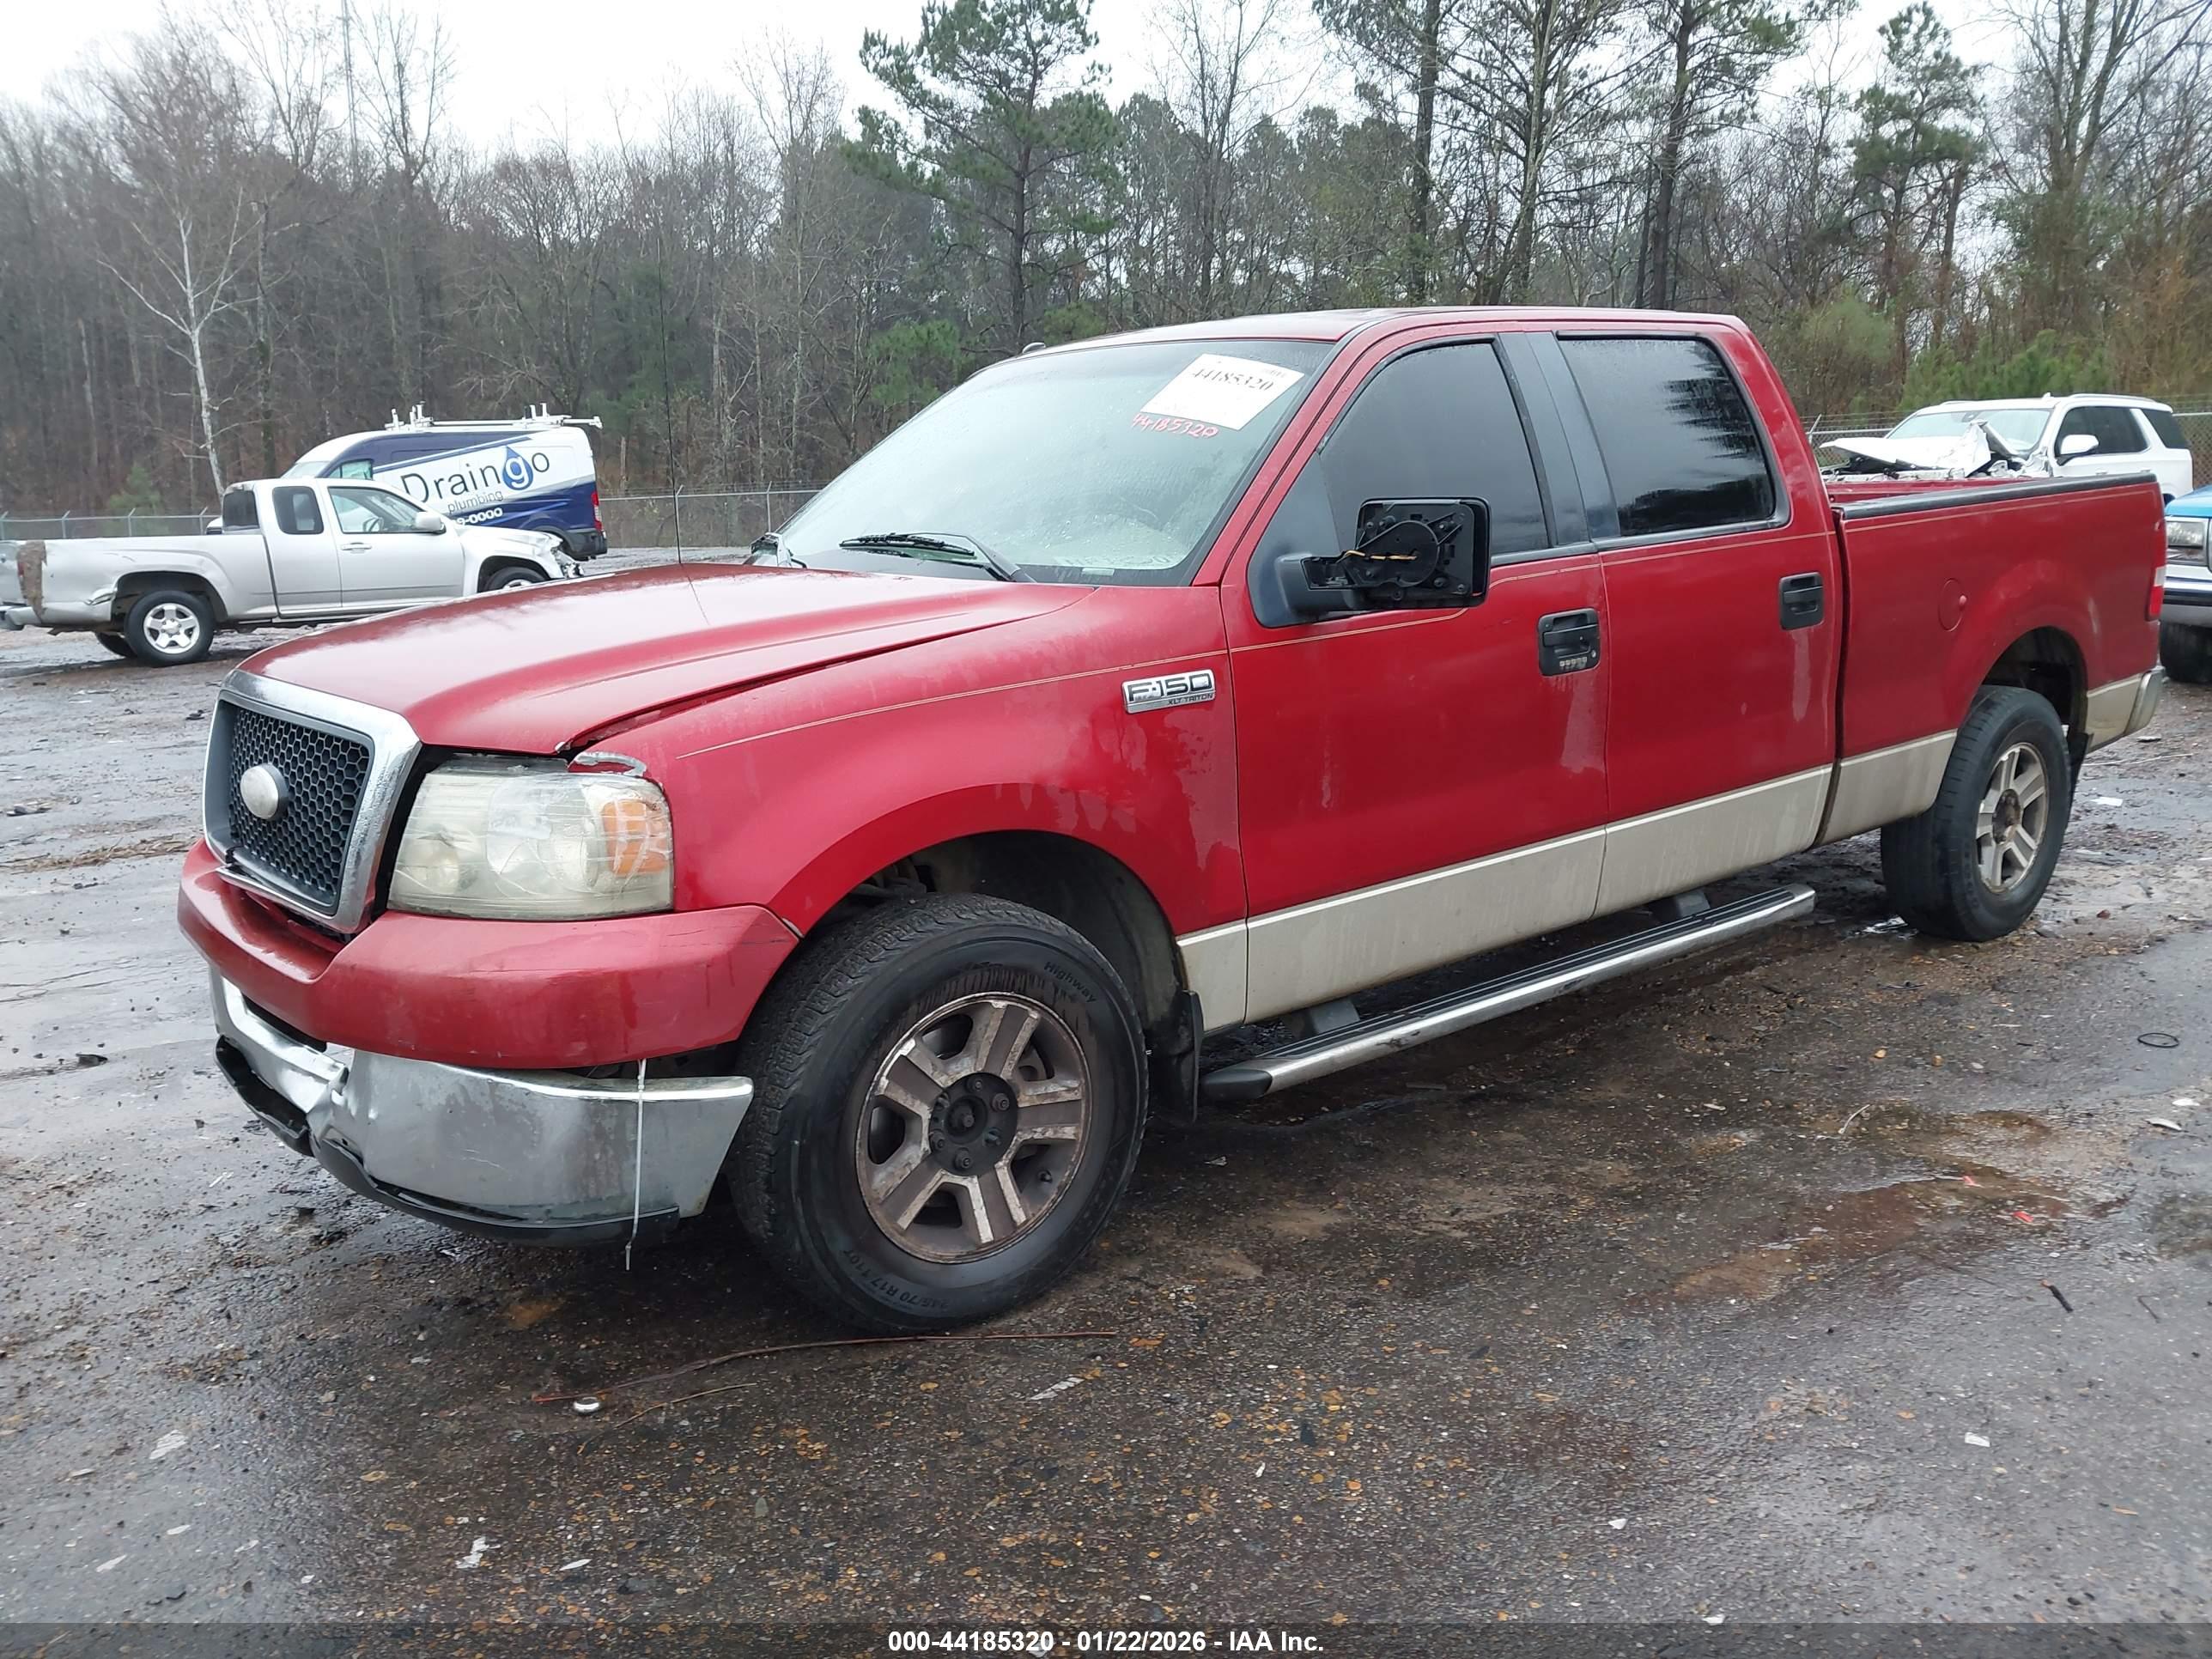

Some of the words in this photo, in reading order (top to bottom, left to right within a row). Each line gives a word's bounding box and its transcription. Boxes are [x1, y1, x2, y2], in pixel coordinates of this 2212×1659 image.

[1132, 413, 1219, 438] 44185320
[400, 453, 550, 503] Draingo
[447, 490, 503, 515] plumbing
[1127, 673, 1212, 702] F-150
[1168, 696, 1182, 705] XLT
[1184, 693, 1213, 702] TRITON
[1044, 961, 1097, 1003] Highway
[870, 1277, 899, 1297] R17
